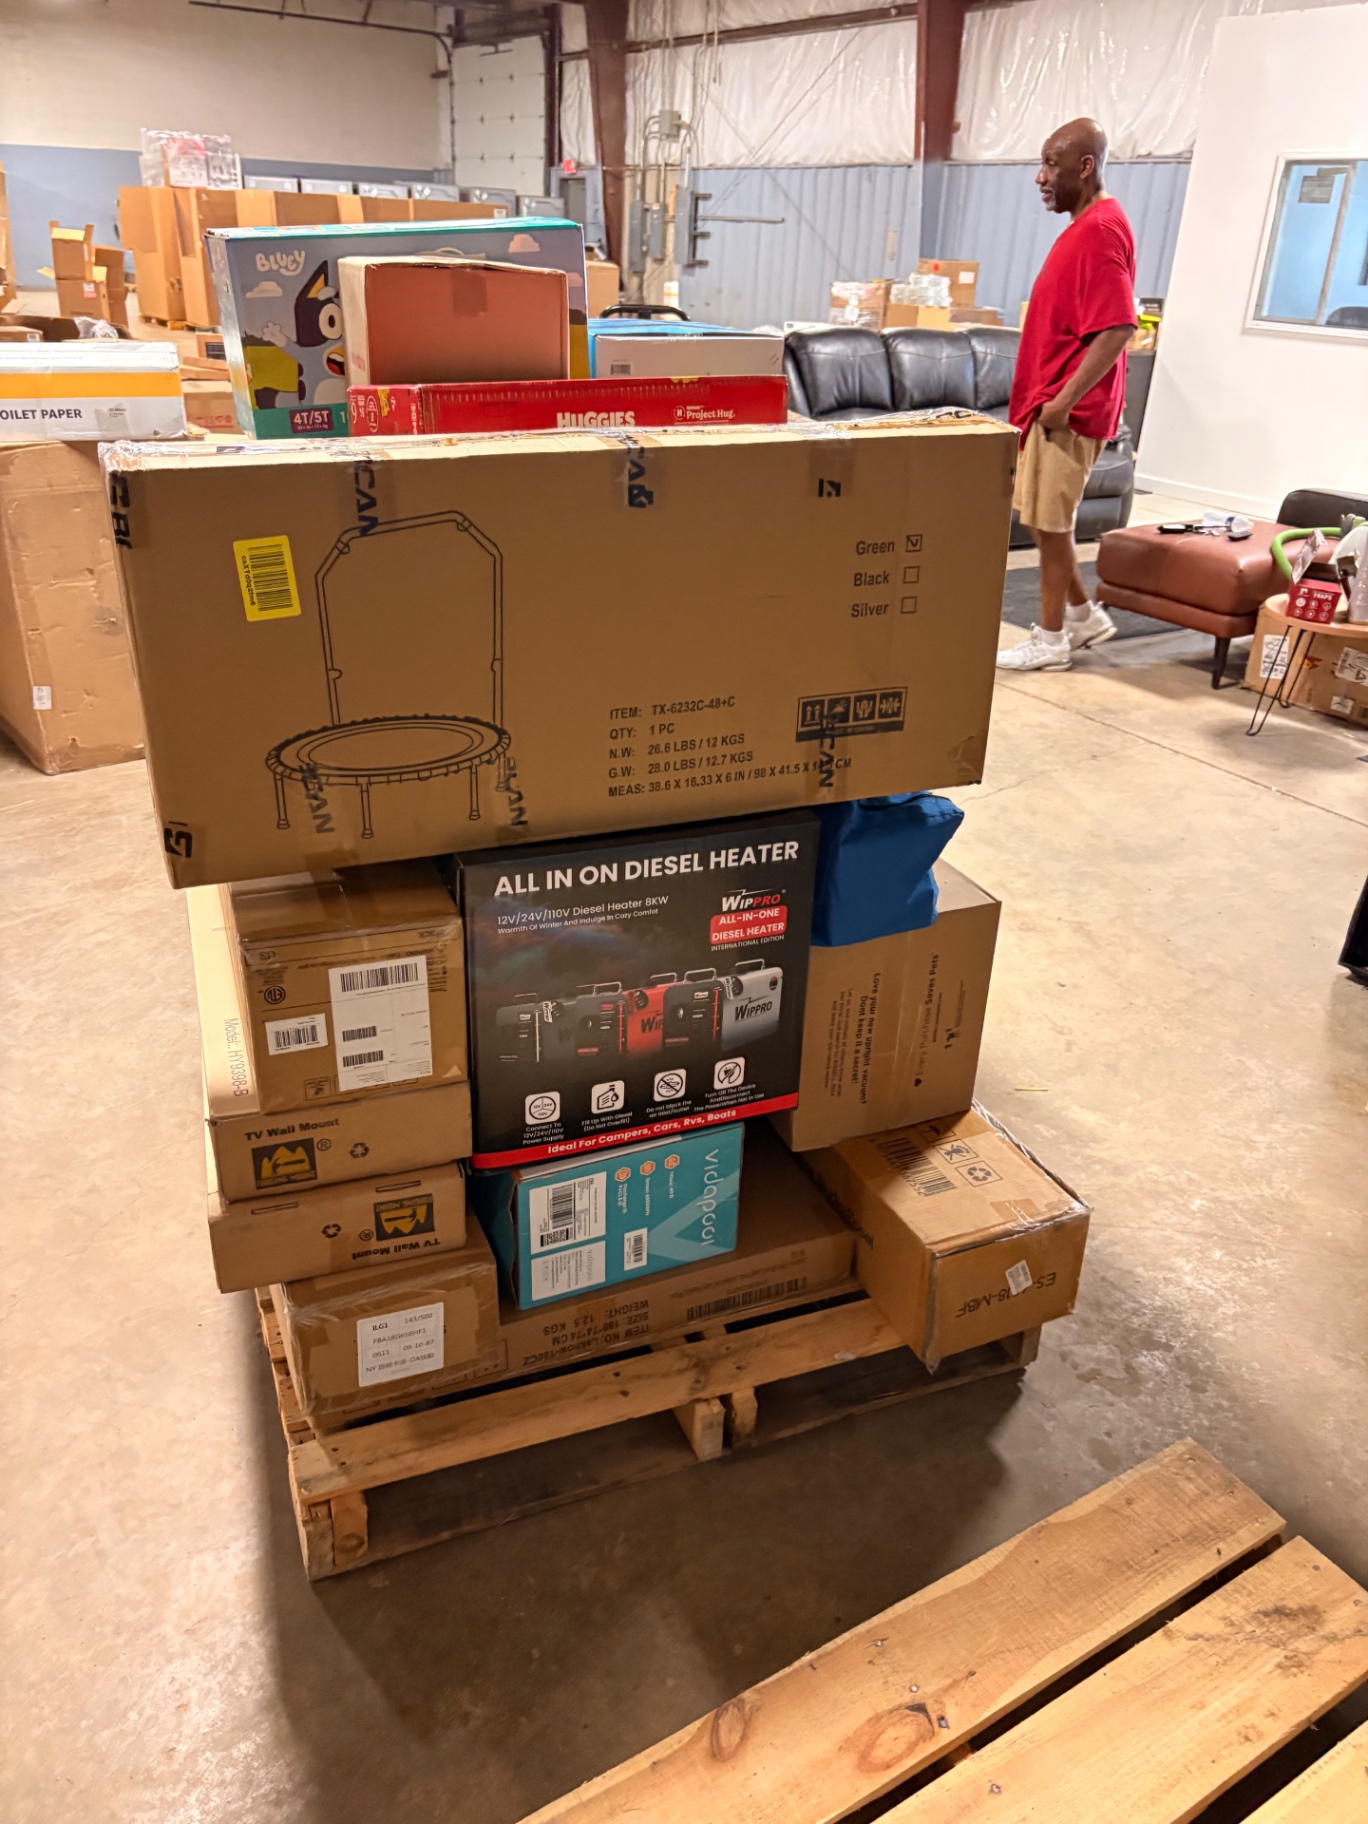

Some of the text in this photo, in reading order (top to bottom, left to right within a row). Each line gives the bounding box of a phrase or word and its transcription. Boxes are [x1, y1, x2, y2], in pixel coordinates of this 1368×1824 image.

[41, 408, 82, 420] PAPER
[294, 410, 330, 424] 4T/5T
[556, 411, 636, 428] HUGGIES
[686, 409, 717, 420] Project
[855, 540, 895, 555] Green
[853, 570, 890, 587] Black
[851, 602, 890, 618] Silver
[610, 696, 736, 720] ITEM: TX-6232C-48+C
[609, 723, 675, 741] QTY: 1 PC
[609, 733, 745, 760] N.W: 26.6 LBS / 12 KGS
[608, 751, 754, 779] G.W: 28.0 LBS / 12.7 KGS
[608, 784, 645, 797] MEAS:
[648, 780, 672, 793] 38.6
[674, 778, 681, 790] X
[685, 774, 713, 788] 16.33
[715, 773, 723, 784] X
[725, 772, 732, 783] 6
[734, 770, 745, 782] IN
[753, 767, 767, 779] 98
[769, 766, 776, 777] X
[779, 763, 800, 776] 41.5
[802, 762, 810, 773] X
[835, 758, 852, 770] CM
[494, 841, 799, 897] ALL IN ON DIESEL HEATER
[497, 895, 670, 925] 12V/24V/110V Diesel Heater 8KW
[719, 908, 780, 925] ALL-IN-ONE
[497, 925, 528, 935] Warmth
[539, 921, 562, 930] Winter
[579, 916, 606, 925] Indulge
[615, 912, 632, 921] Cozy
[712, 922, 785, 942] DIESEL HEATER
[711, 934, 785, 952] INTERNATIONAL EDITION
[929, 954, 940, 976] Pets
[925, 977, 936, 1005] Saves
[855, 1018, 864, 1039] keep
[919, 1005, 932, 1049] Purchase
[860, 973, 882, 1105] Love your new upright vacuum?
[244, 1118, 340, 1141] TV Wall Mount
[522, 1134, 565, 1145] Power Supply
[548, 1109, 737, 1154] Ideal For Campers, Cars, Rvs, Boats
[351, 1237, 441, 1260] TV Wall Mount
[605, 1299, 649, 1319] WEIGHT:
[543, 1322, 567, 1336] KGS
[624, 1324, 649, 1339] ITEM
[552, 1333, 568, 1347] CM
